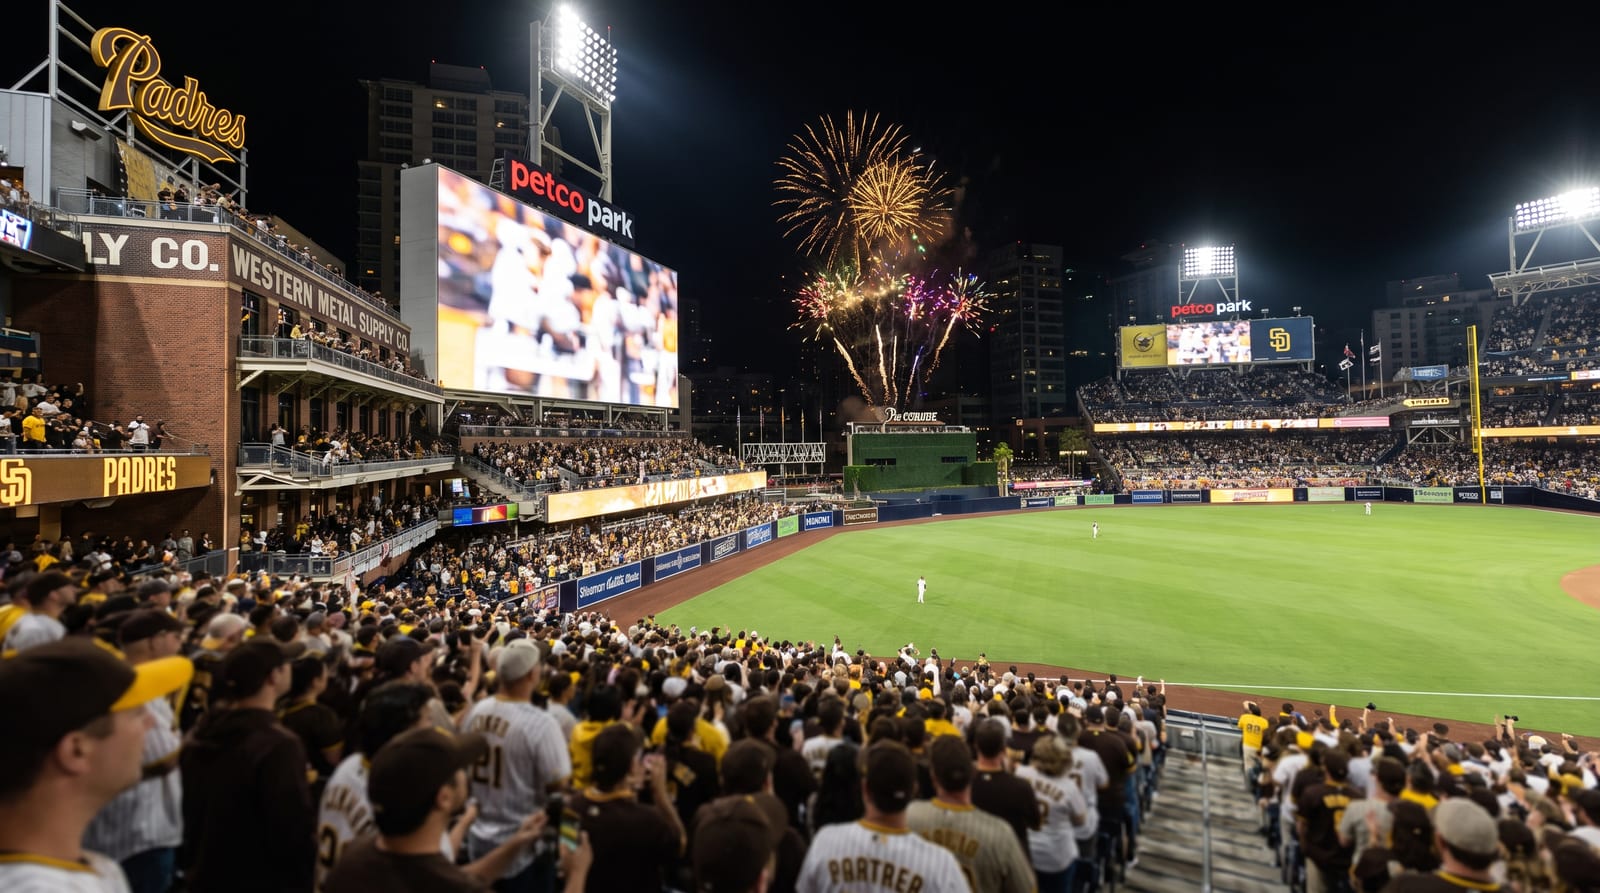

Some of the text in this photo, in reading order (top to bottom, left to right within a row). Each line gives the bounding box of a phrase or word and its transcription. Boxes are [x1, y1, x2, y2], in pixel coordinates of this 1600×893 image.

[91, 28, 246, 149] Padres
[511, 159, 633, 239] petco park
[151, 237, 219, 272] CO.
[232, 243, 409, 353] WESTERN METAL SUPPLY CO.
[1171, 299, 1252, 318] petco park
[103, 456, 177, 498] PADRES
